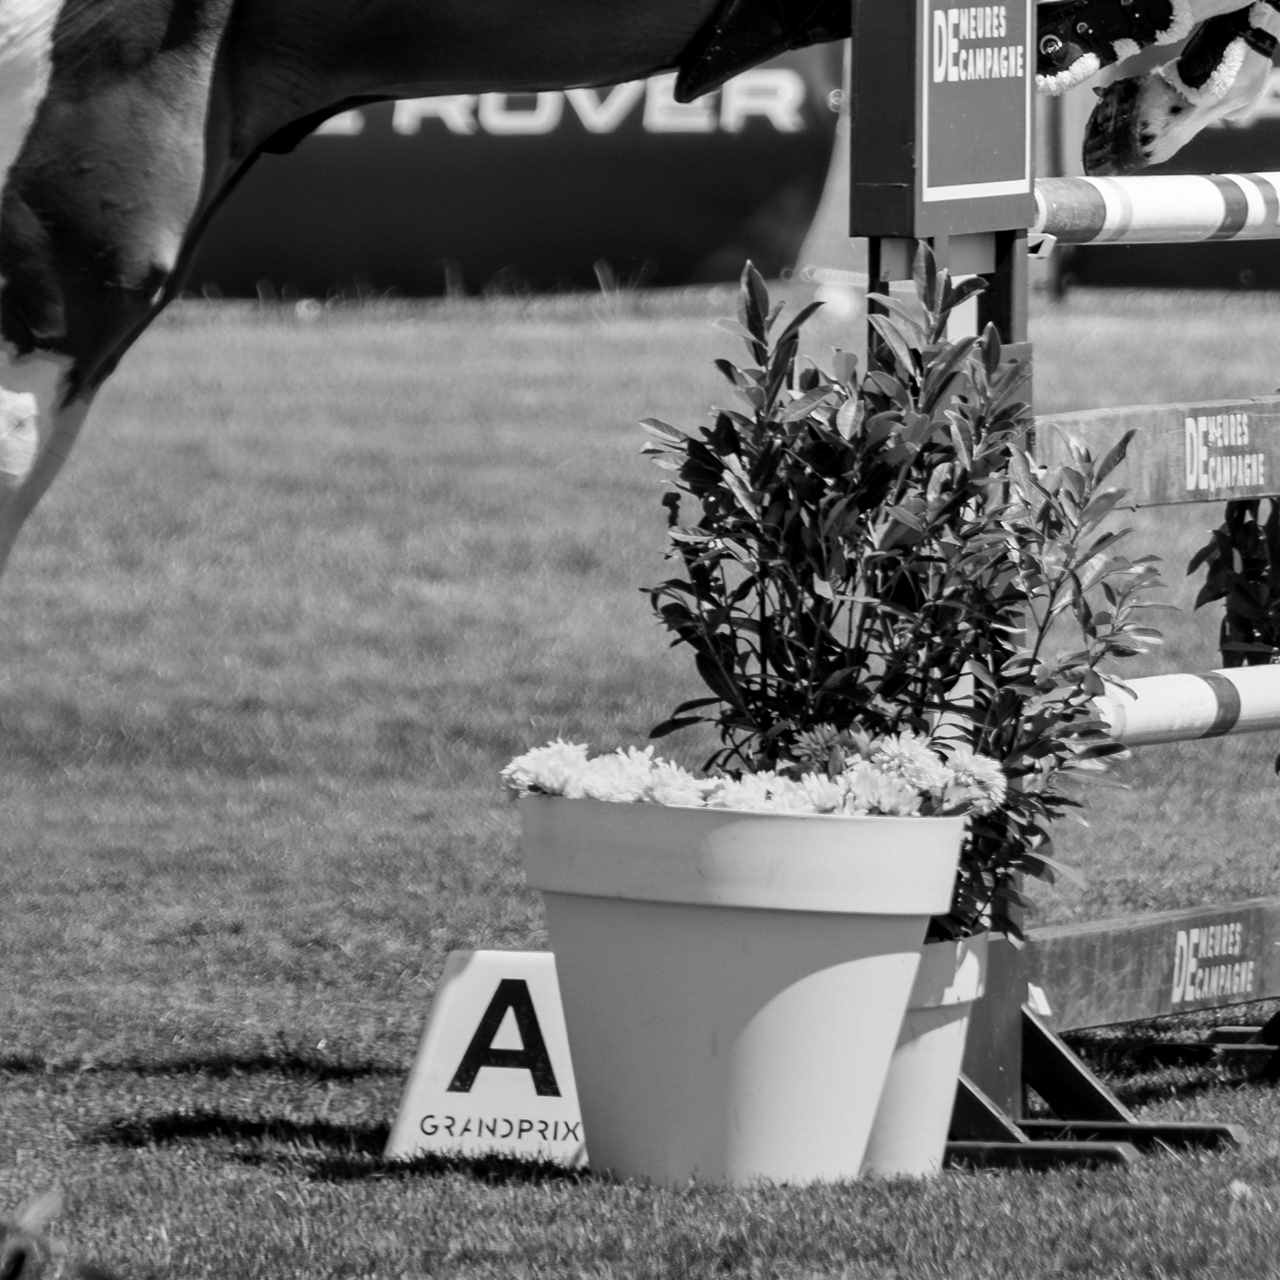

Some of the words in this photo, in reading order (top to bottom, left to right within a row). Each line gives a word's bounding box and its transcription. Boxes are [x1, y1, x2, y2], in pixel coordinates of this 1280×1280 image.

[933, 9, 959, 83] DE
[959, 45, 1024, 81] CAMPAGNE
[1208, 453, 1265, 492] CAMPAGNE
[1195, 961, 1254, 1000] CAMPAGNE
[446, 978, 562, 1097] A
[420, 1114, 581, 1142] GRANDPRIX
